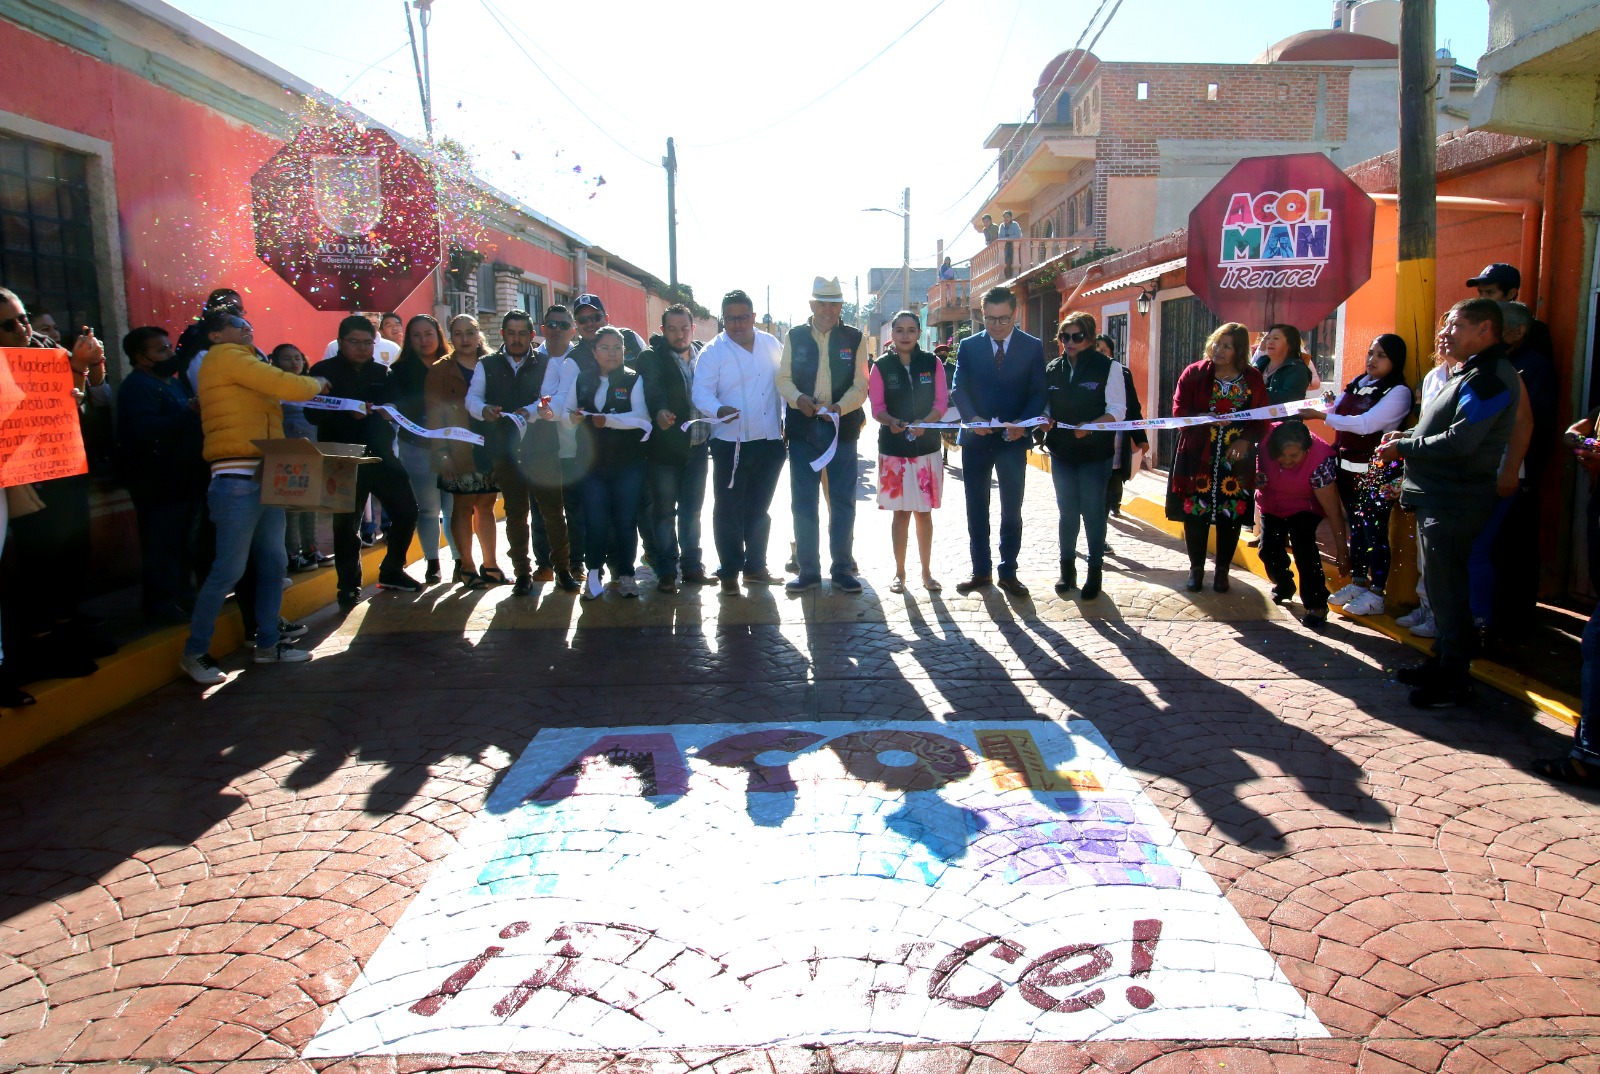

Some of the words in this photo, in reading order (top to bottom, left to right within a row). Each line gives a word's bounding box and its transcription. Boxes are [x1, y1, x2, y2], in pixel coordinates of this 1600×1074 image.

[1223, 188, 1331, 227] ACOL
[1221, 223, 1331, 263] MAN
[1219, 264, 1324, 289] ¡Renace!
